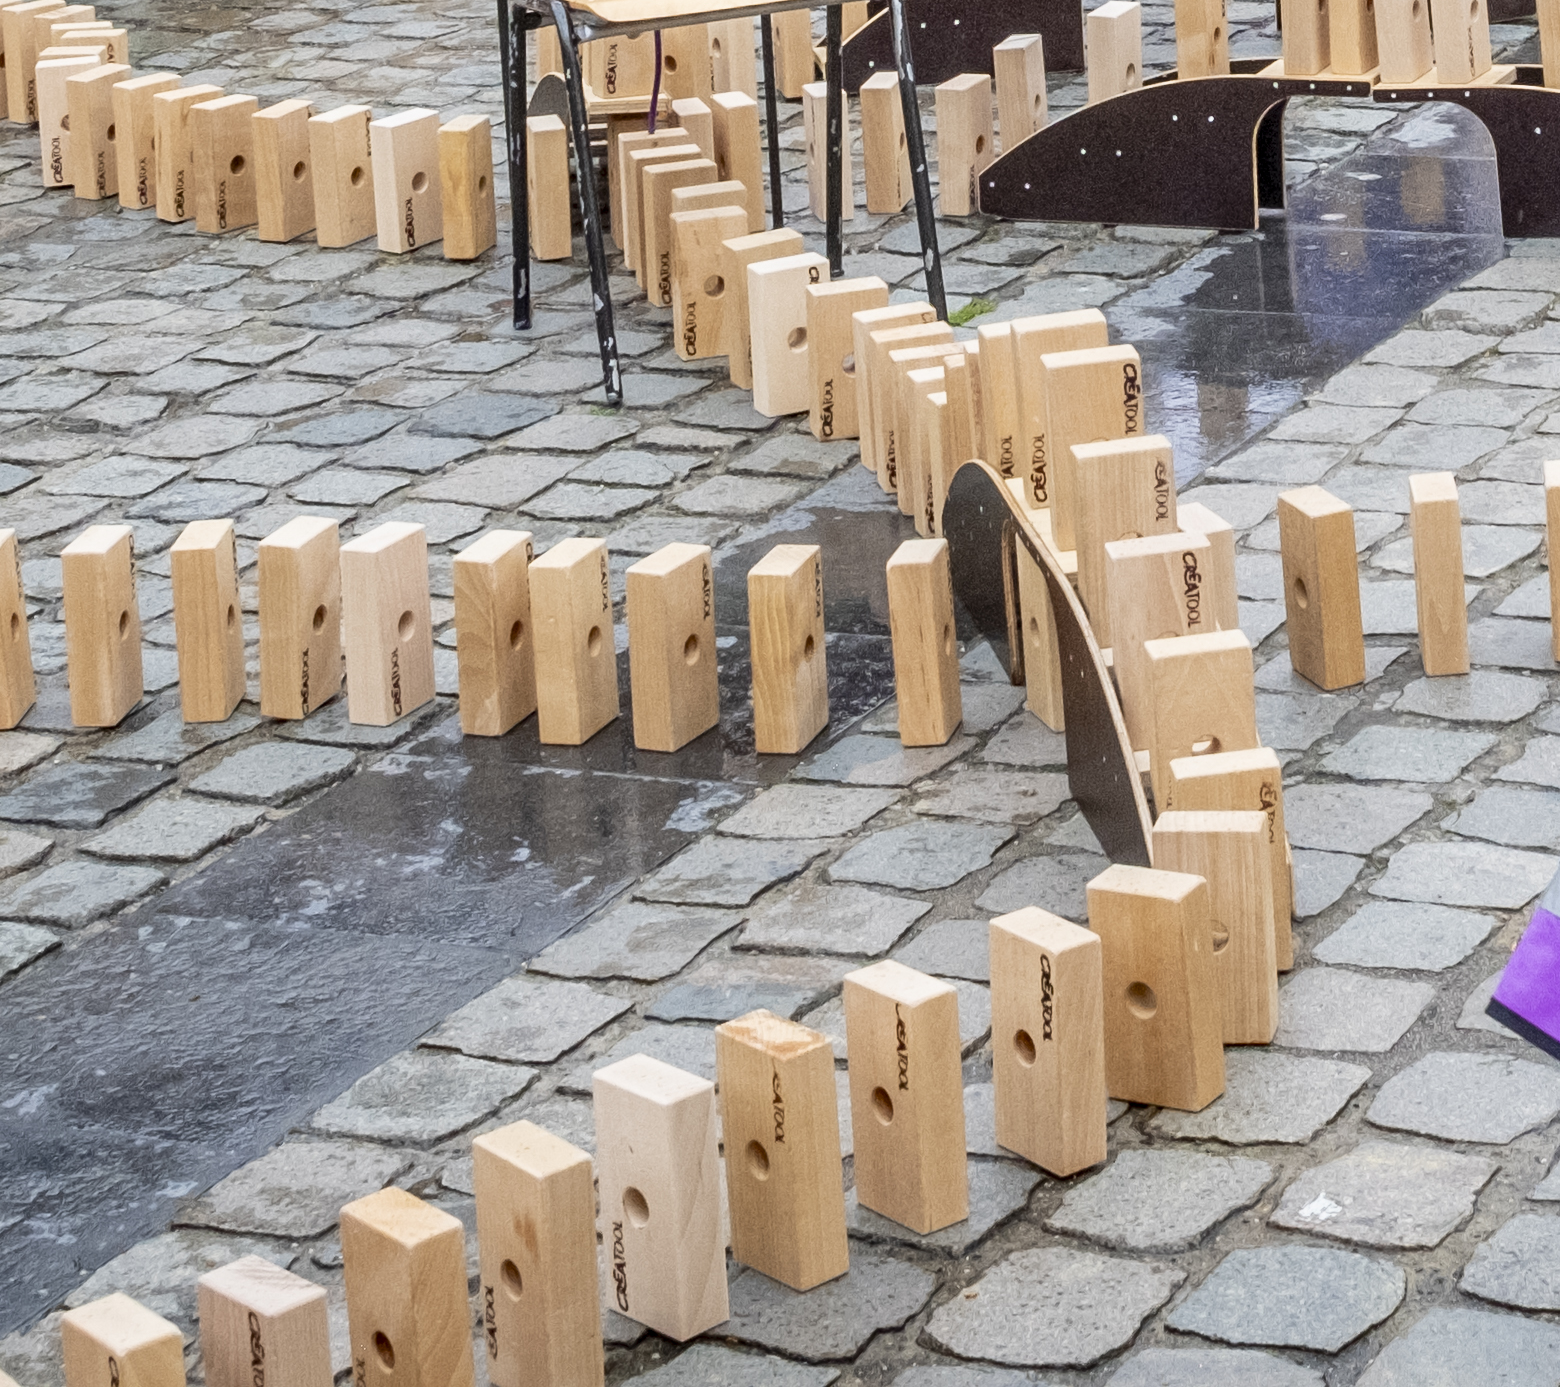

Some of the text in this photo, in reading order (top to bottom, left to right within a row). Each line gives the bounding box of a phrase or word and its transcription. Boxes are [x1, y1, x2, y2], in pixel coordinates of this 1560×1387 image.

[52, 136, 64, 184] CREATOOL
[683, 301, 696, 357] CREATOOL
[1123, 362, 1138, 433] CREATOOL
[1000, 434, 1012, 477] ATOOL
[1032, 432, 1046, 504] CREATOOL
[1182, 550, 1200, 629] CREATOOL
[1039, 953, 1053, 1043] CREATOOL
[612, 1219, 629, 1313] CREATOOL
